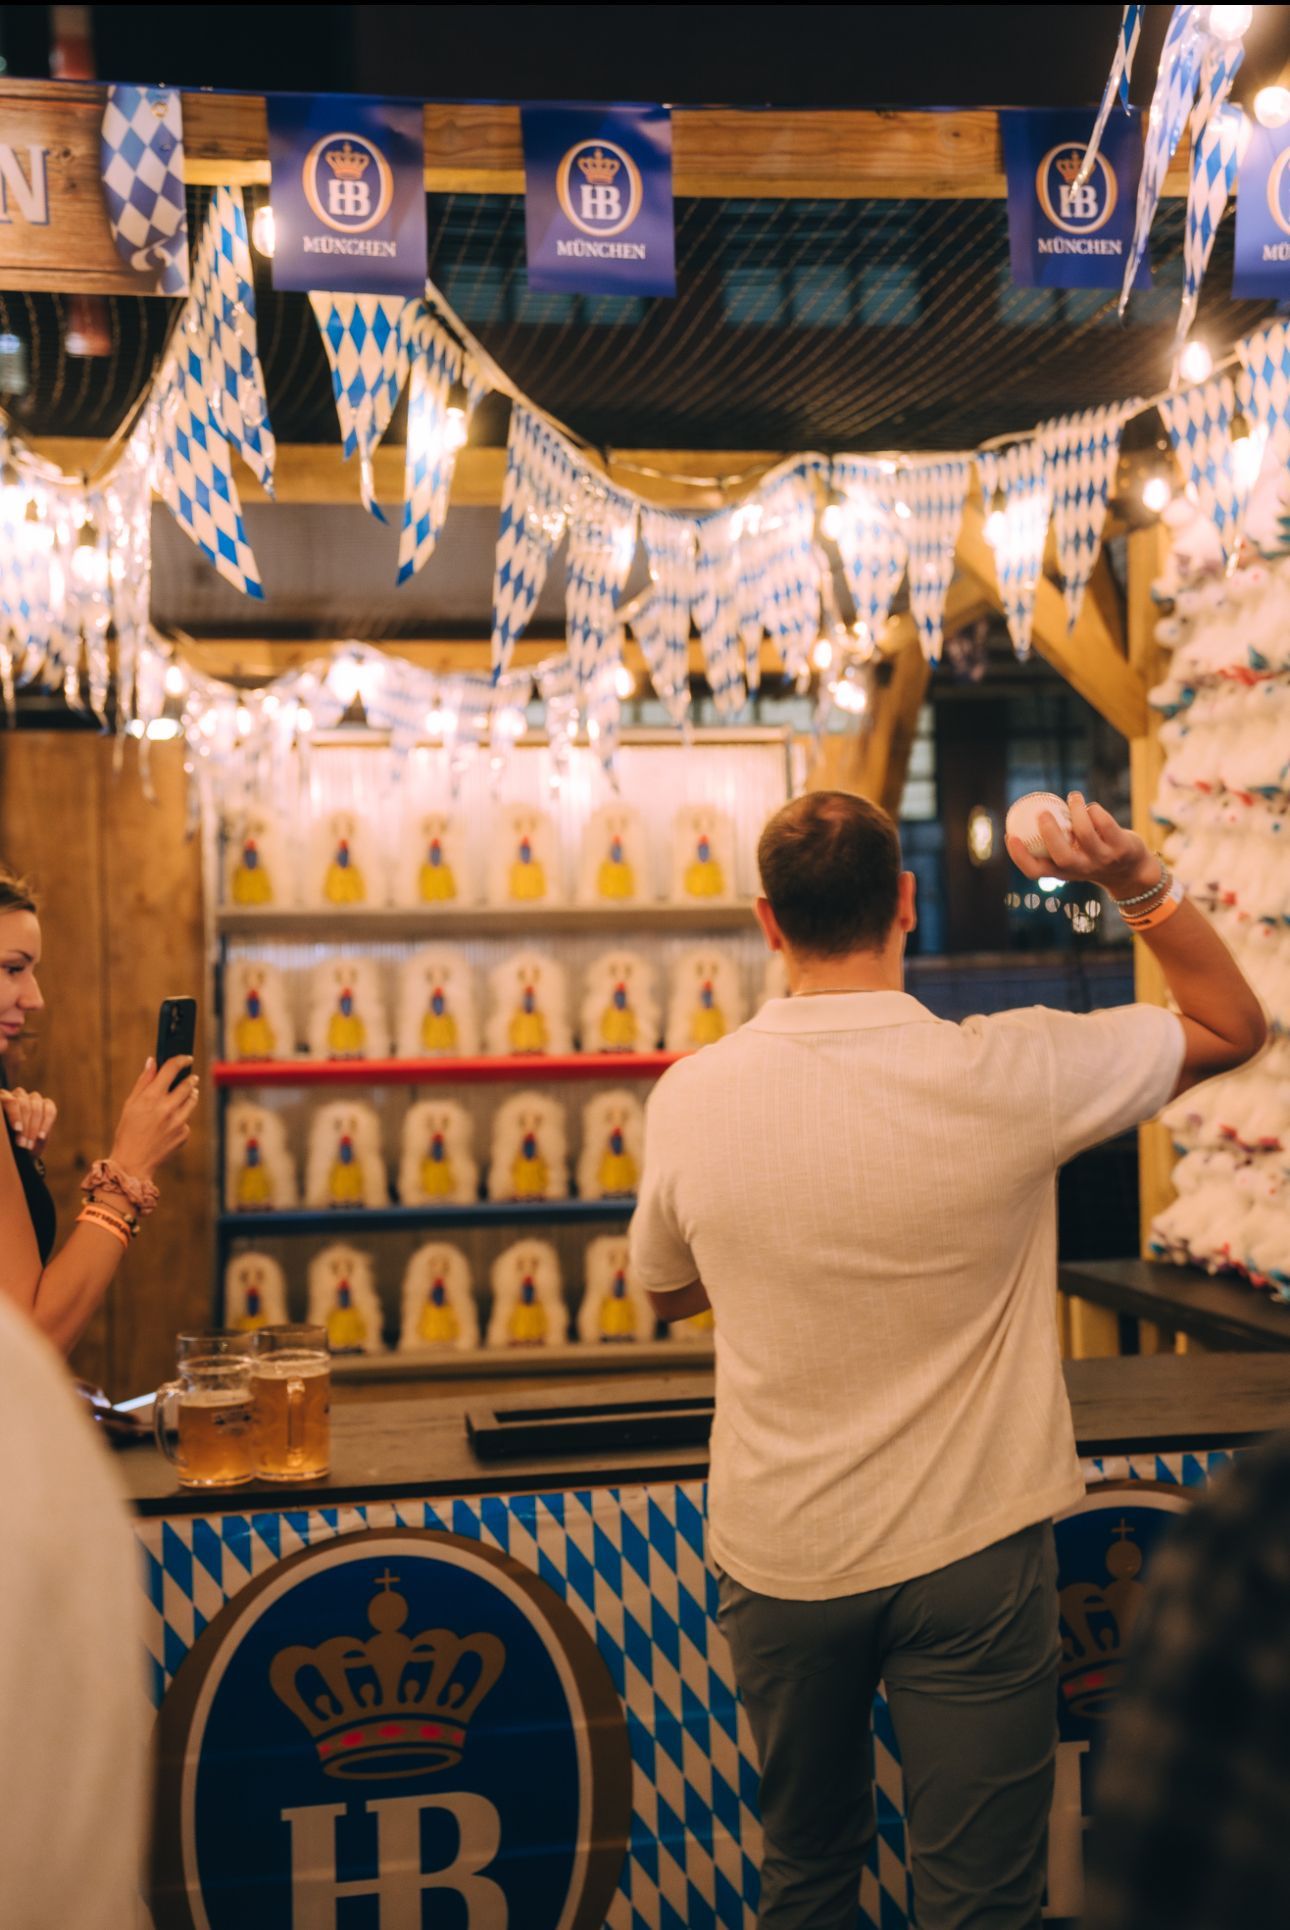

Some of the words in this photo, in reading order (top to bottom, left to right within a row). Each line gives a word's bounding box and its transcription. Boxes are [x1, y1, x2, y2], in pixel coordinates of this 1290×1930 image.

[328, 179, 371, 217] HB
[580, 184, 622, 220] HB
[1059, 185, 1098, 218] HB
[303, 235, 397, 257] MÜNCHEN
[556, 239, 646, 259] MÜNCHEN
[1037, 236, 1122, 255] MÜNCHEN
[280, 1791, 509, 1930] HB
